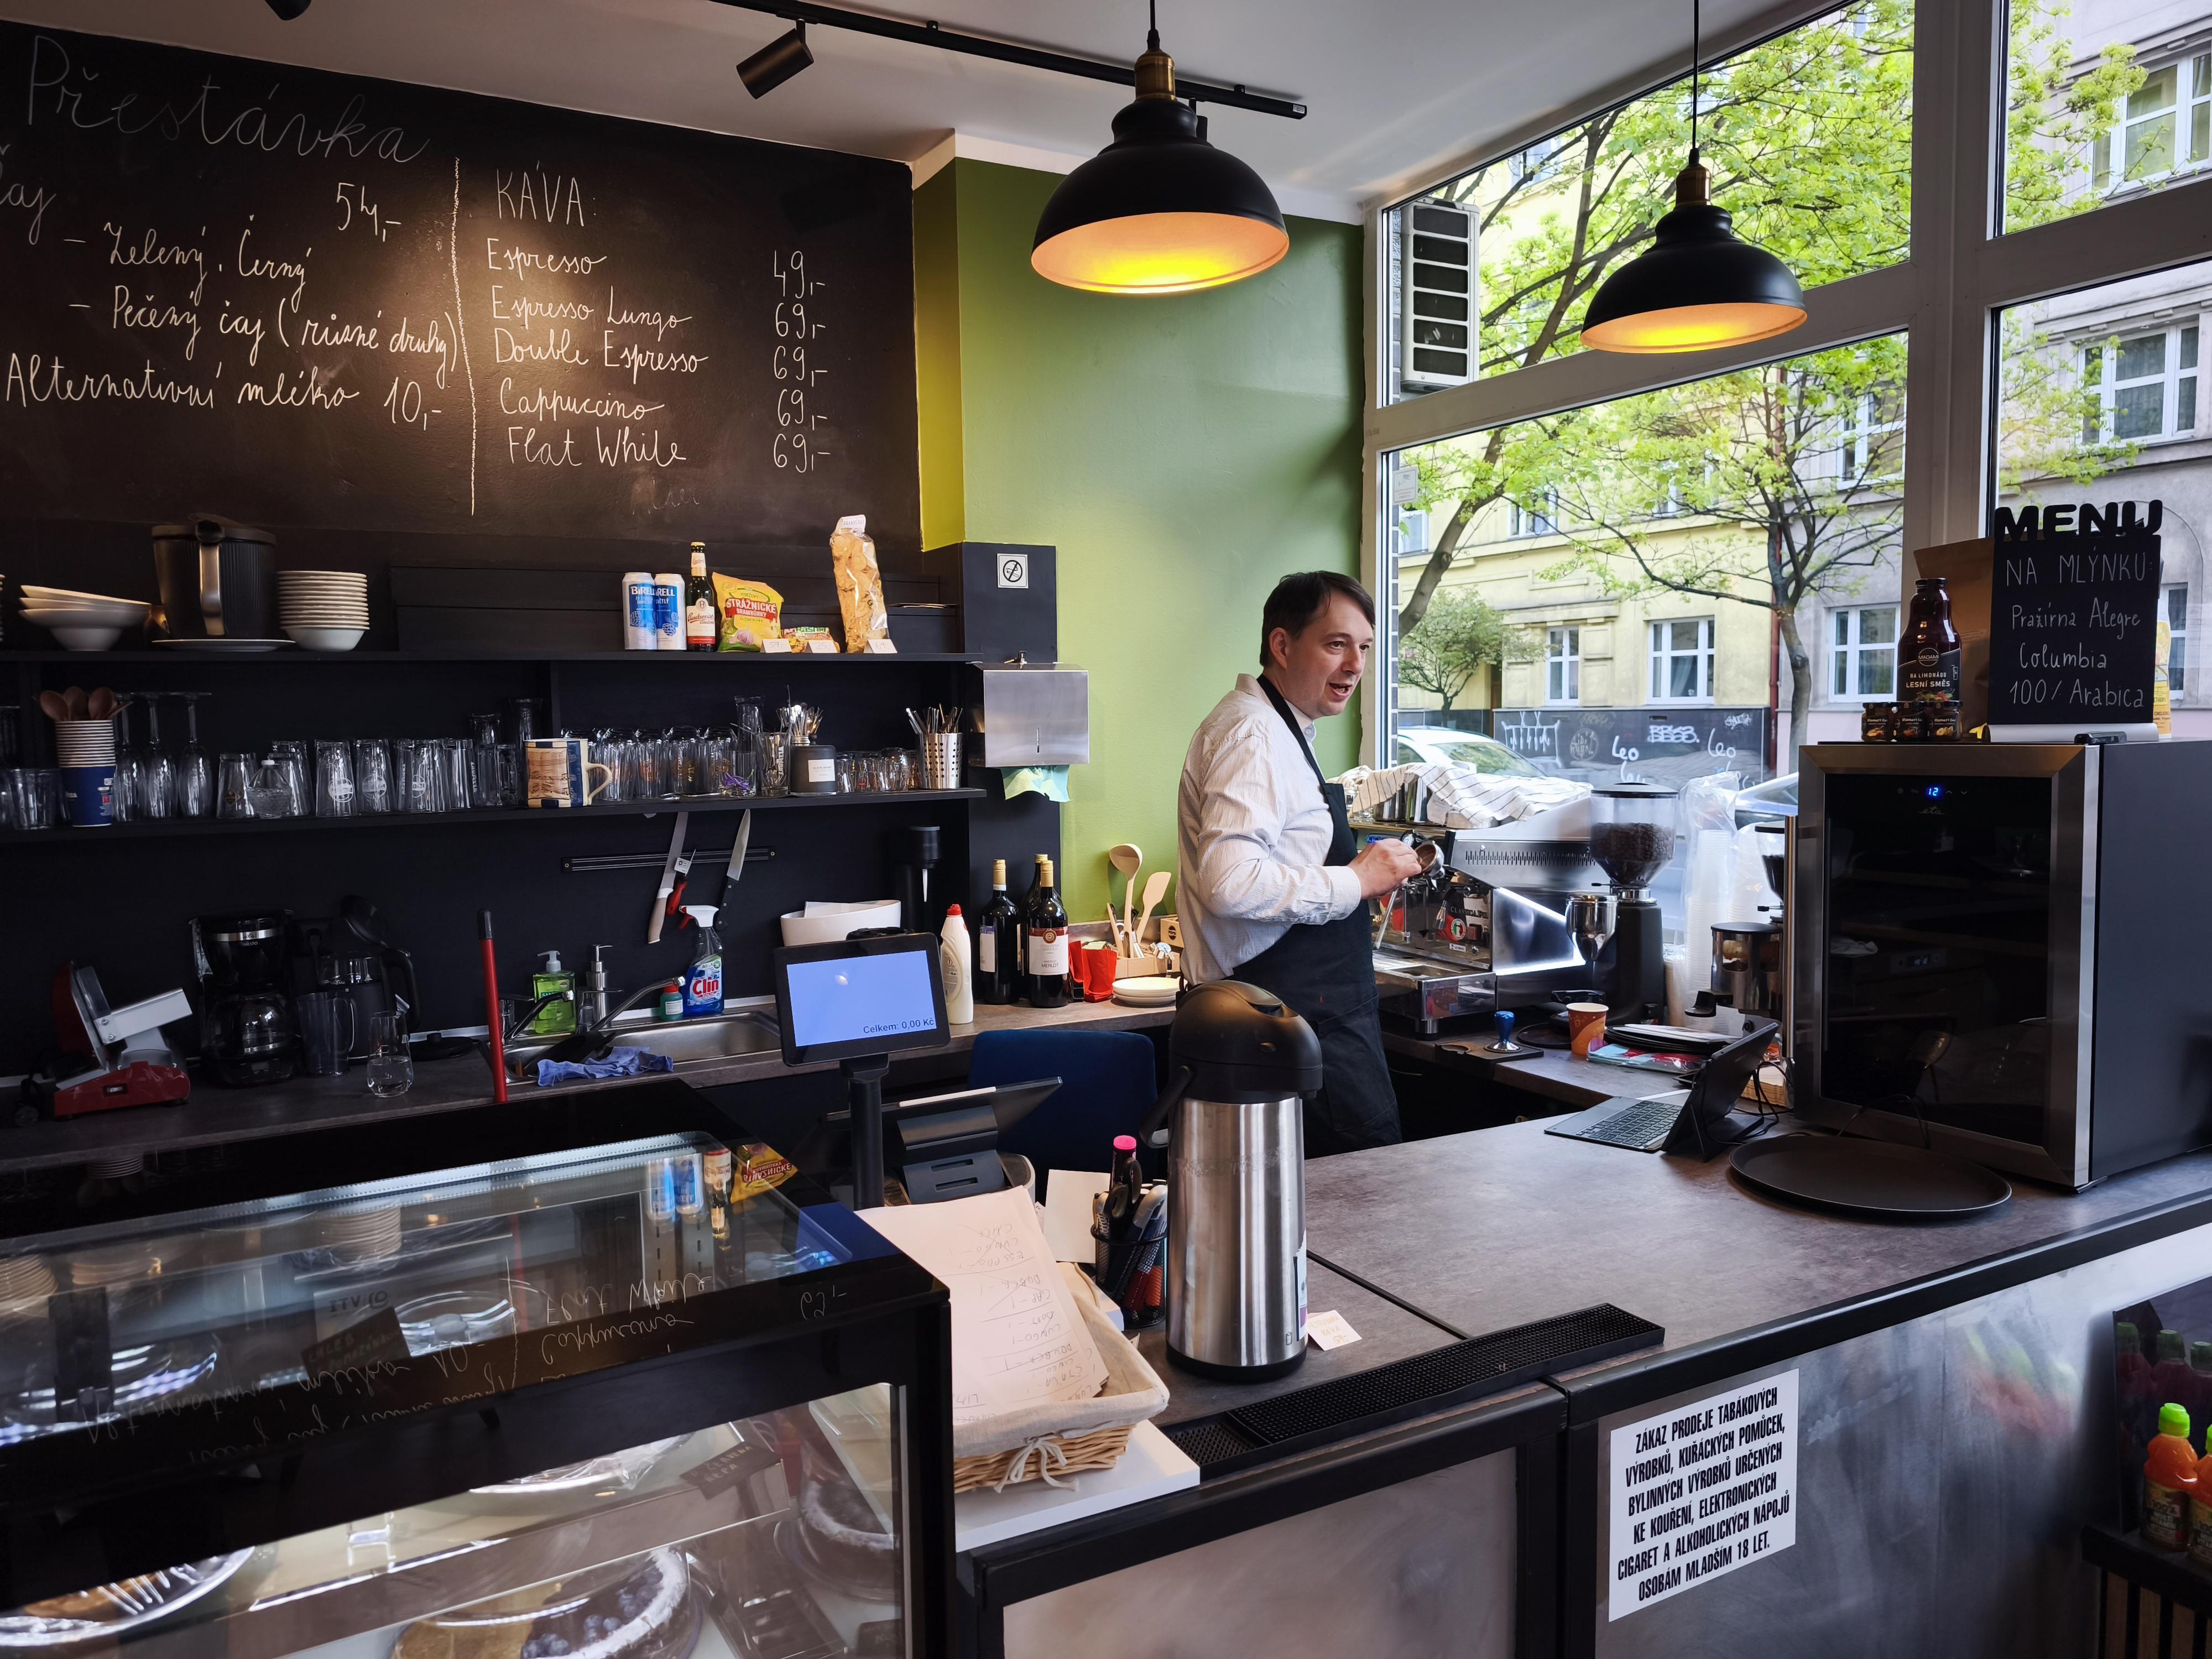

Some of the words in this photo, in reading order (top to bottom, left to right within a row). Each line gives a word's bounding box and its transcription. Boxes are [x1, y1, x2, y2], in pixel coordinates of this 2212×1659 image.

[28, 35, 430, 163] Přestávka
[487, 238, 607, 280] Espresso
[773, 251, 826, 300] 49,-
[113, 285, 201, 361] Pečený
[492, 285, 595, 328] Espresso
[607, 285, 693, 342] Lungo
[775, 303, 827, 340] 69,-
[6, 352, 224, 409] Alternativní
[237, 366, 361, 410] mléko
[493, 328, 589, 366] Double
[603, 330, 709, 385] Espresso
[773, 346, 828, 388] 69,-
[499, 377, 665, 422] Cappuccino
[777, 389, 828, 431] 69,-
[507, 426, 582, 467] Flat
[773, 434, 832, 473] 69,-
[1995, 499, 2163, 540] MENU
[2006, 556, 2037, 587] NA
[727, 598, 776, 614] STRÁŽNICKÉ
[2088, 597, 2141, 640] Alegre
[2020, 642, 2107, 668] Columbia
[1929, 679, 1951, 687] SMĚS
[2069, 678, 2144, 708] Arabica
[1611, 735, 1640, 761] Leo
[1928, 786, 1939, 796] 12
[692, 978, 719, 995] Clin
[863, 1024, 899, 1034] Celkem:
[901, 1019, 920, 1030] 0,00
[923, 1018, 934, 1026] Kč
[1635, 1425, 1667, 1454] ZÁKAZ
[1671, 1409, 1714, 1442] PRODEJE
[1718, 1387, 1778, 1422] TABÁKOVÝCH
[1625, 1448, 1674, 1488] VÝROBKŮ,
[1678, 1430, 1735, 1468] KUŘÁCKÝCH
[1738, 1413, 1786, 1445] POMŮCEK,
[1628, 1476, 1683, 1517] BYLINNÝCH
[1687, 1455, 1731, 1495] VÝROBKŮ
[1735, 1441, 1783, 1475] URČENÝCH
[1618, 1546, 1659, 1581] CIGARET
[1663, 1541, 1670, 1563] A
[1675, 1507, 1750, 1558] ALKOHOLICKÝCH
[1753, 1489, 1791, 1526] NÁPOJŮ
[1633, 1522, 1646, 1545] KE
[1650, 1500, 1695, 1538] KOUŘENÍ,
[1699, 1472, 1777, 1519] ELEKTRONICKÝCH
[1638, 1566, 1682, 1602] OSOBÁM
[1686, 1544, 1733, 1583] MLADŠÍM
[1737, 1540, 1749, 1561] 18
[1753, 1530, 1771, 1553] LET.
